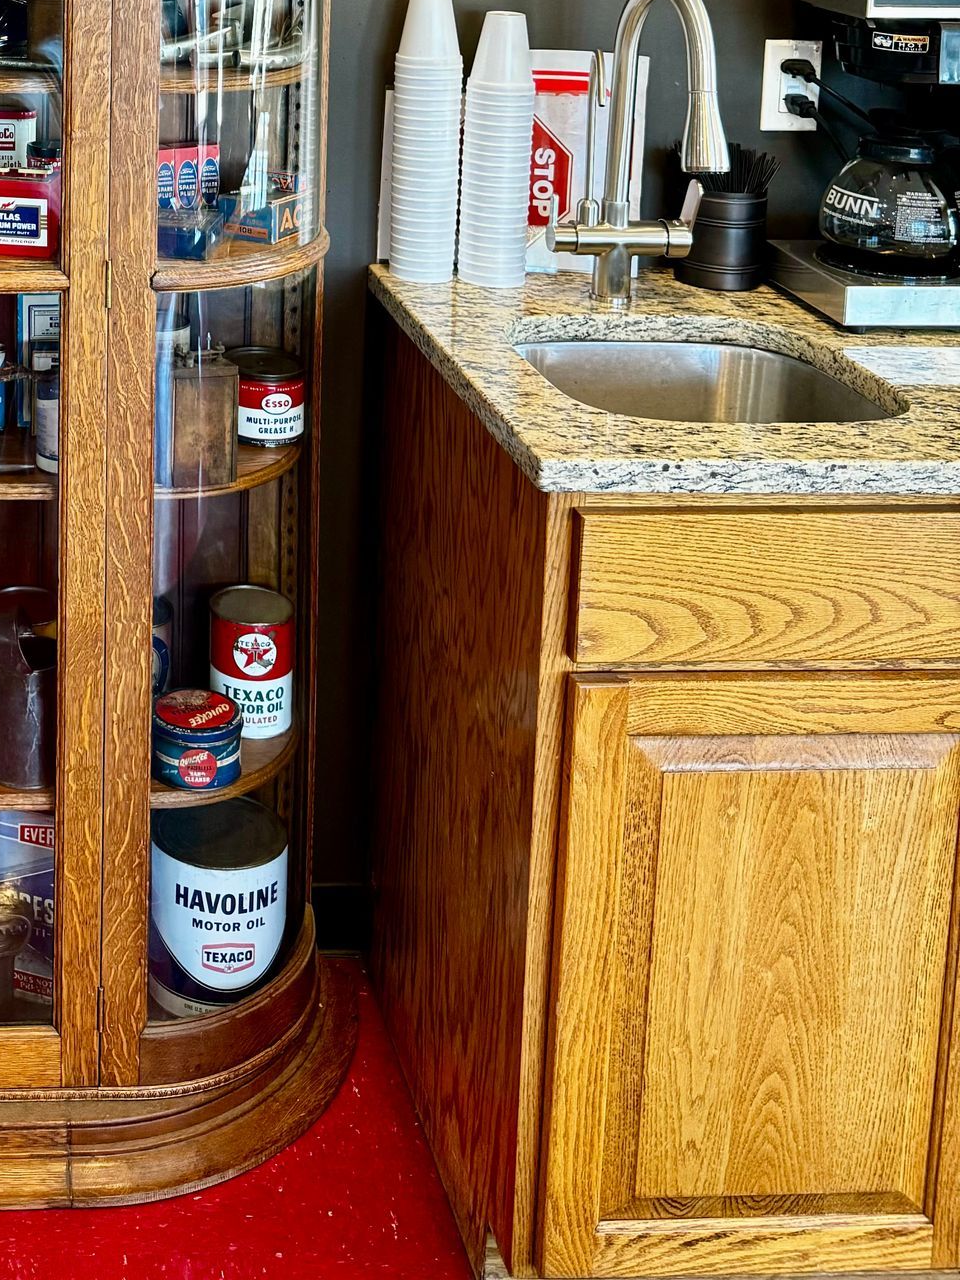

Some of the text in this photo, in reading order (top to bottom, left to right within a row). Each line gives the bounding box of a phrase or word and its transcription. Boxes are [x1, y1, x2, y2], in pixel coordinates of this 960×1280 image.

[532, 147, 556, 218] STOP
[825, 188, 880, 218] BUNN
[11, 222, 37, 230] POWER
[264, 398, 290, 409] Esso
[246, 413, 302, 425] MULTI-PURPOSE
[239, 639, 272, 648] TEXACO
[222, 682, 285, 702] TEXACO
[179, 751, 210, 767] QUICKEE
[184, 775, 211, 783] CLEANER
[24, 826, 54, 846] EVER
[174, 880, 279, 916] HAVOLINE
[191, 916, 266, 932] MOTOR OIL
[203, 949, 254, 964] TEXACO
